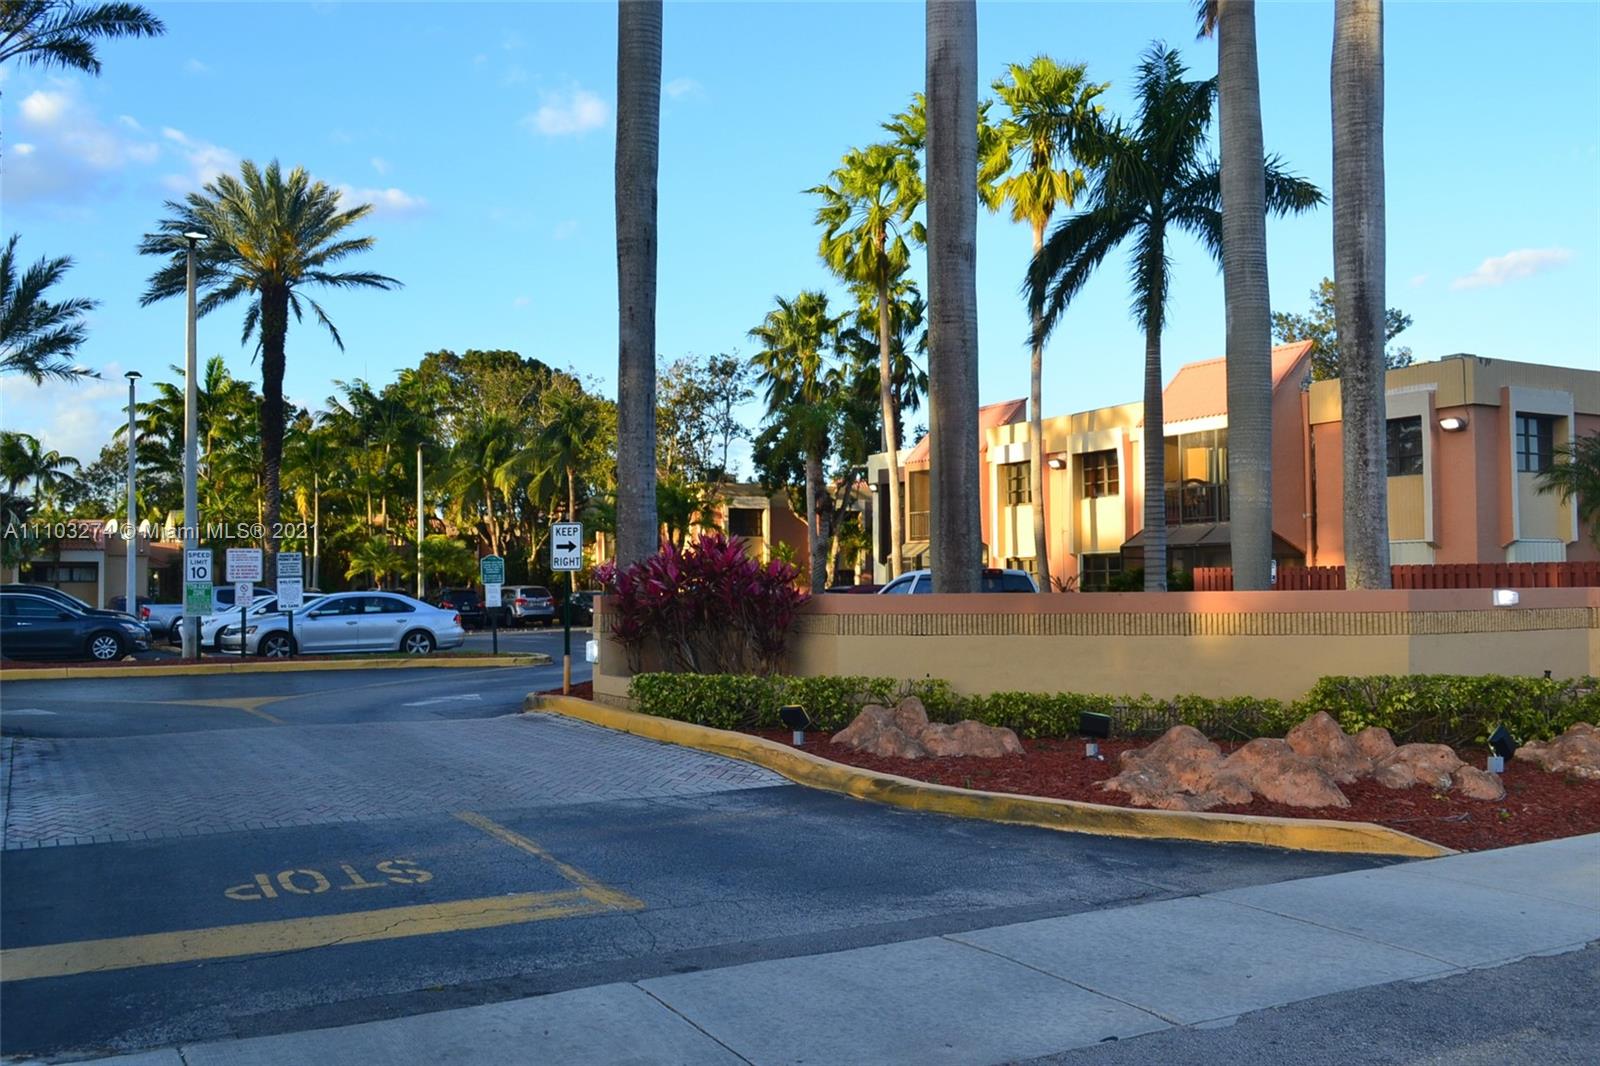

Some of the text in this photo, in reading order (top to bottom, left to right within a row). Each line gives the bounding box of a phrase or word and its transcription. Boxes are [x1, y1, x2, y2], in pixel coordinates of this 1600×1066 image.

[555, 527, 579, 536] KEEP
[553, 557, 580, 567] RIGHT
[191, 566, 207, 579] 10
[224, 859, 434, 901] STOP
